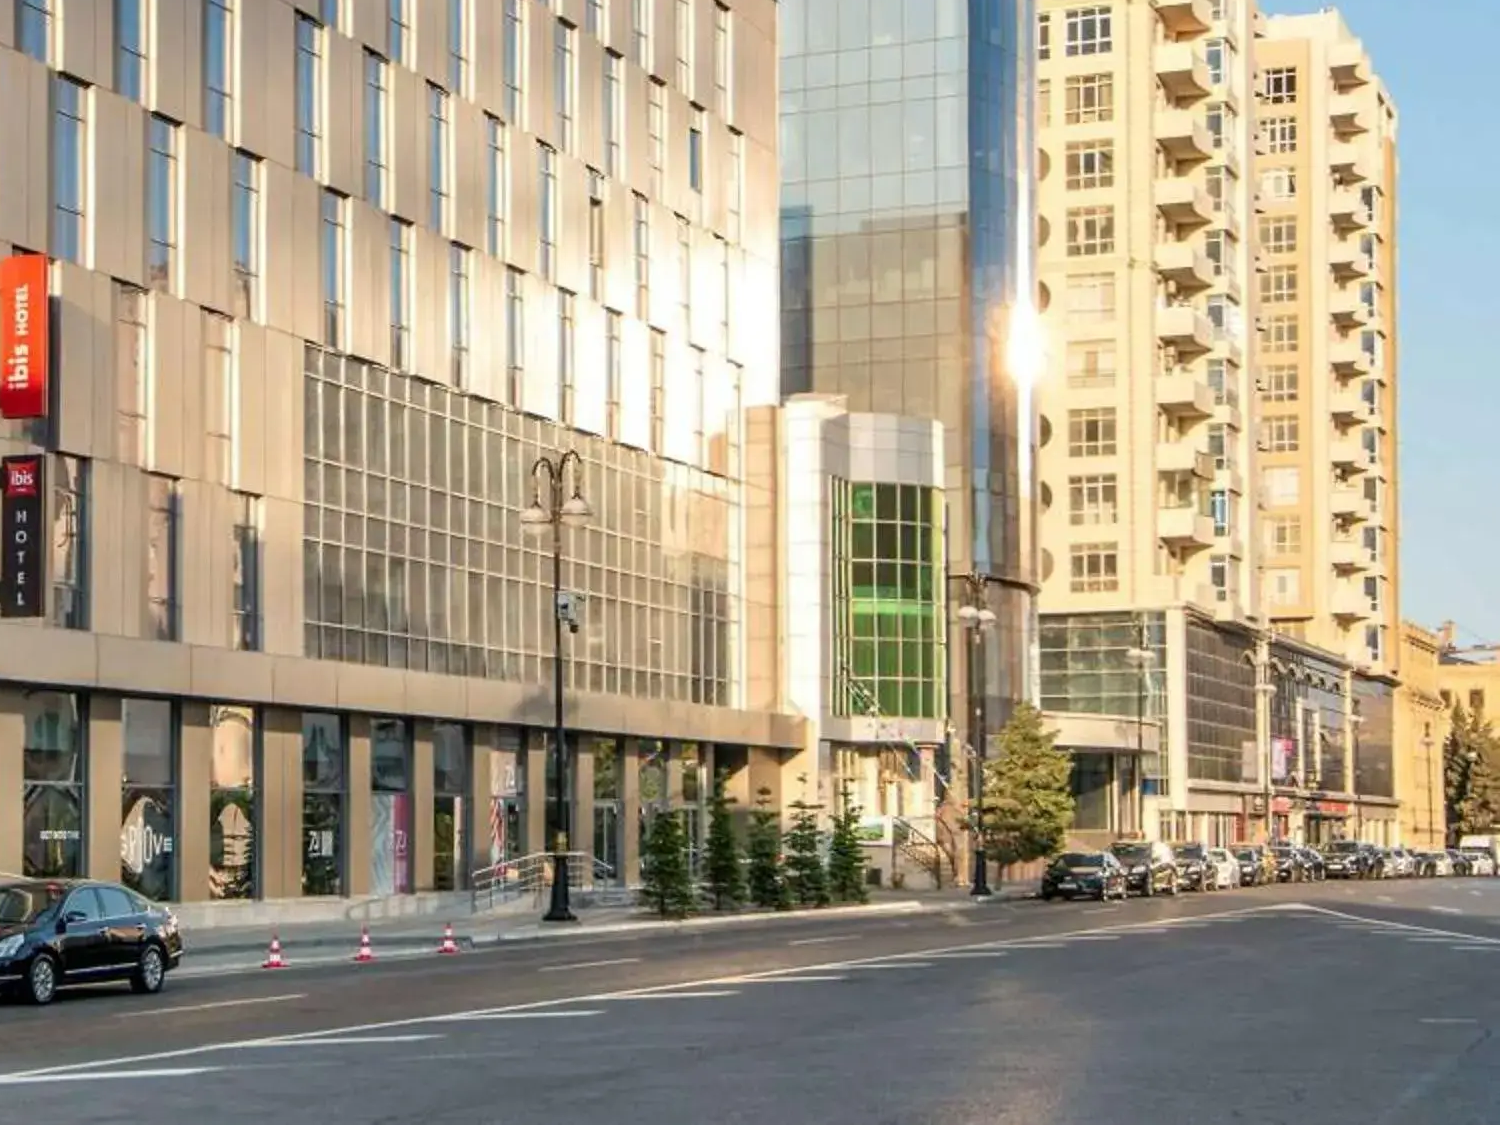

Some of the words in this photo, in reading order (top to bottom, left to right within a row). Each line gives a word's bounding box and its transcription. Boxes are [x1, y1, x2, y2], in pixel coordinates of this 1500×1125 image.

[14, 282, 29, 337] HOTEL
[7, 343, 29, 390] ibis
[10, 469, 34, 486] ibis
[14, 509, 28, 606] HOTEL
